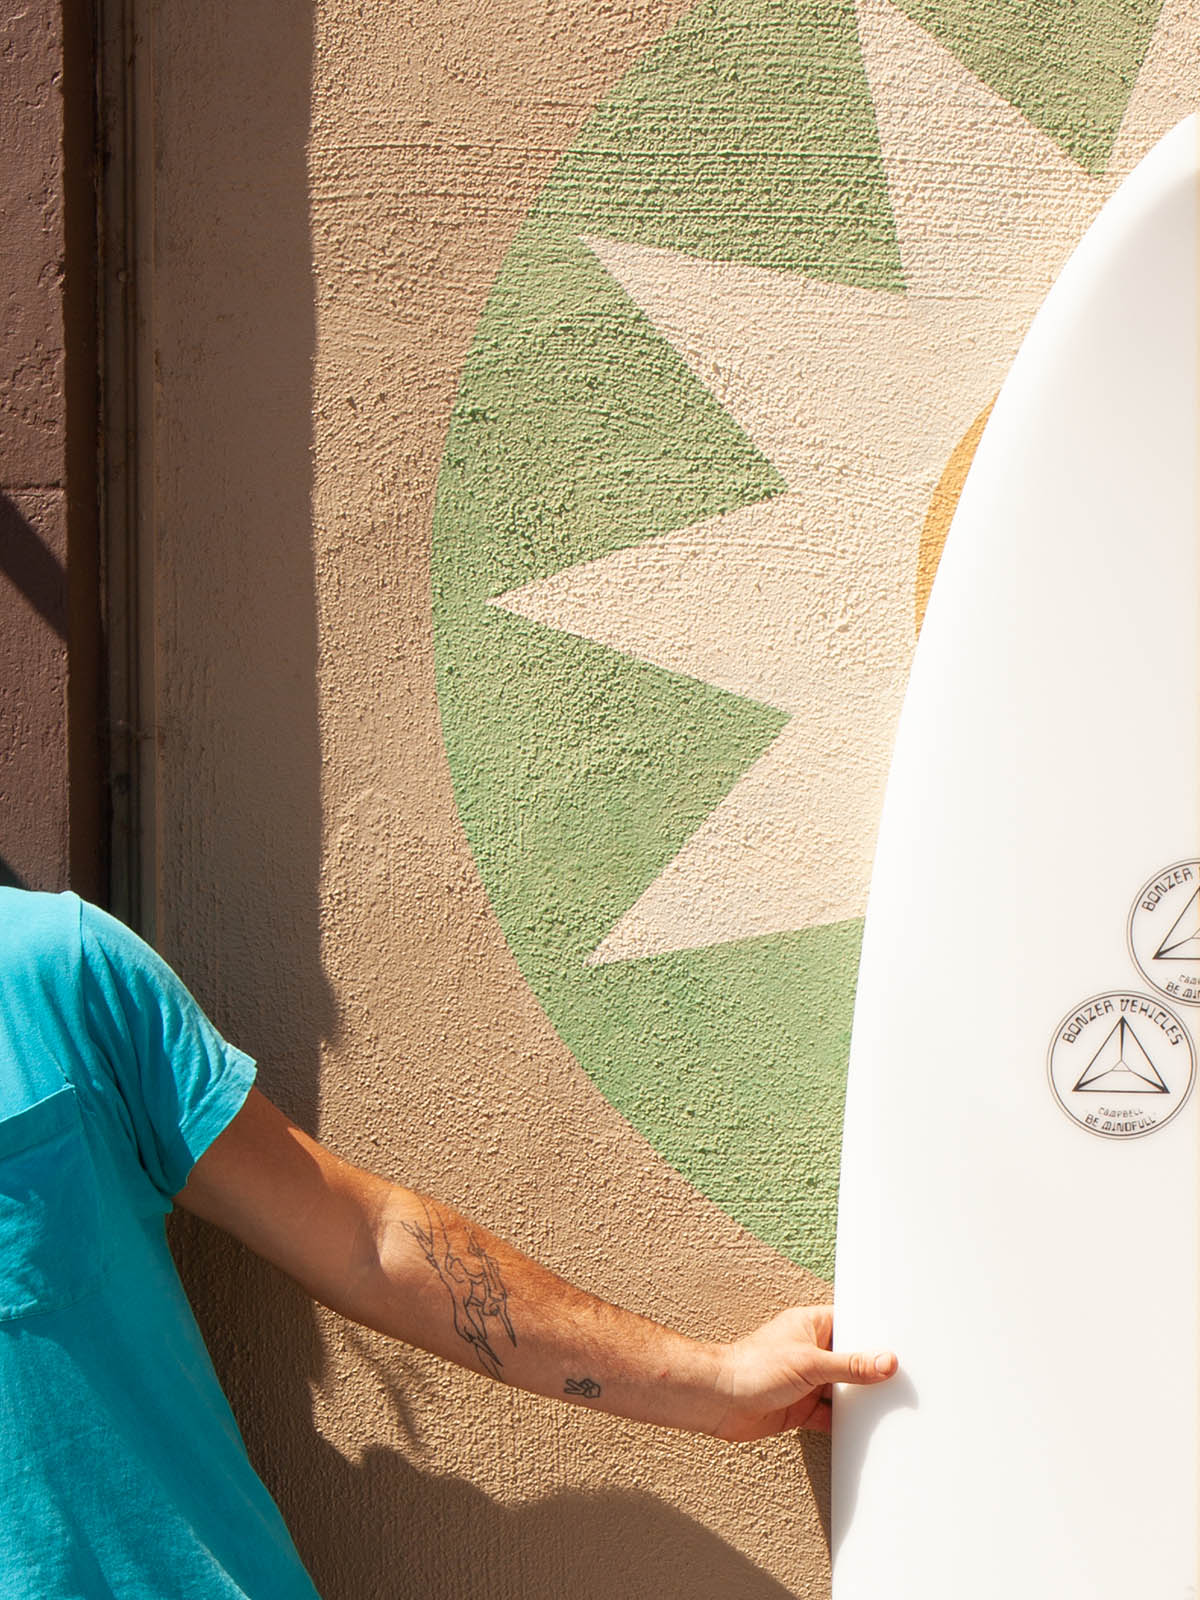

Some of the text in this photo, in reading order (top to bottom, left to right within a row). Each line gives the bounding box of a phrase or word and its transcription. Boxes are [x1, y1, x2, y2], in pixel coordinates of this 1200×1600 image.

[1141, 867, 1194, 912] BONZER
[1166, 981, 1180, 995] BE
[1062, 998, 1184, 1046] BONZER VEHICLES
[1085, 1113, 1157, 1132] BE MINDFULL
